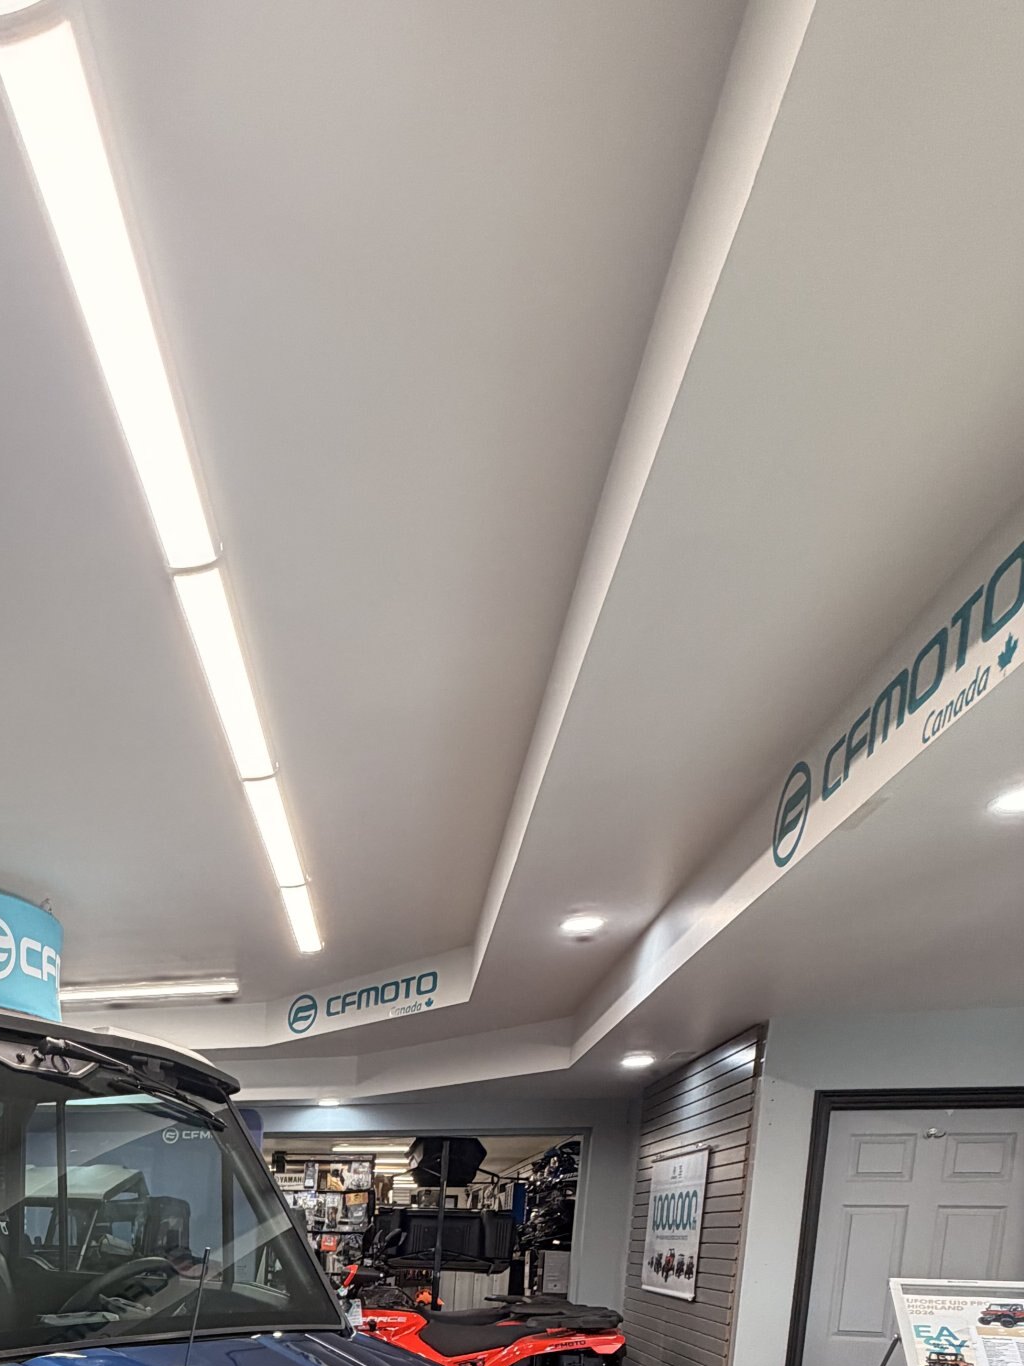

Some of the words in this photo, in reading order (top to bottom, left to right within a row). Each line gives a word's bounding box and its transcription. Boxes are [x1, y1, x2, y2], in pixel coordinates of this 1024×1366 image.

[821, 541, 1024, 801] CFMOTO
[921, 666, 991, 744] Canada
[326, 971, 438, 1017] CFMOTO
[389, 1001, 422, 1017] Canada
